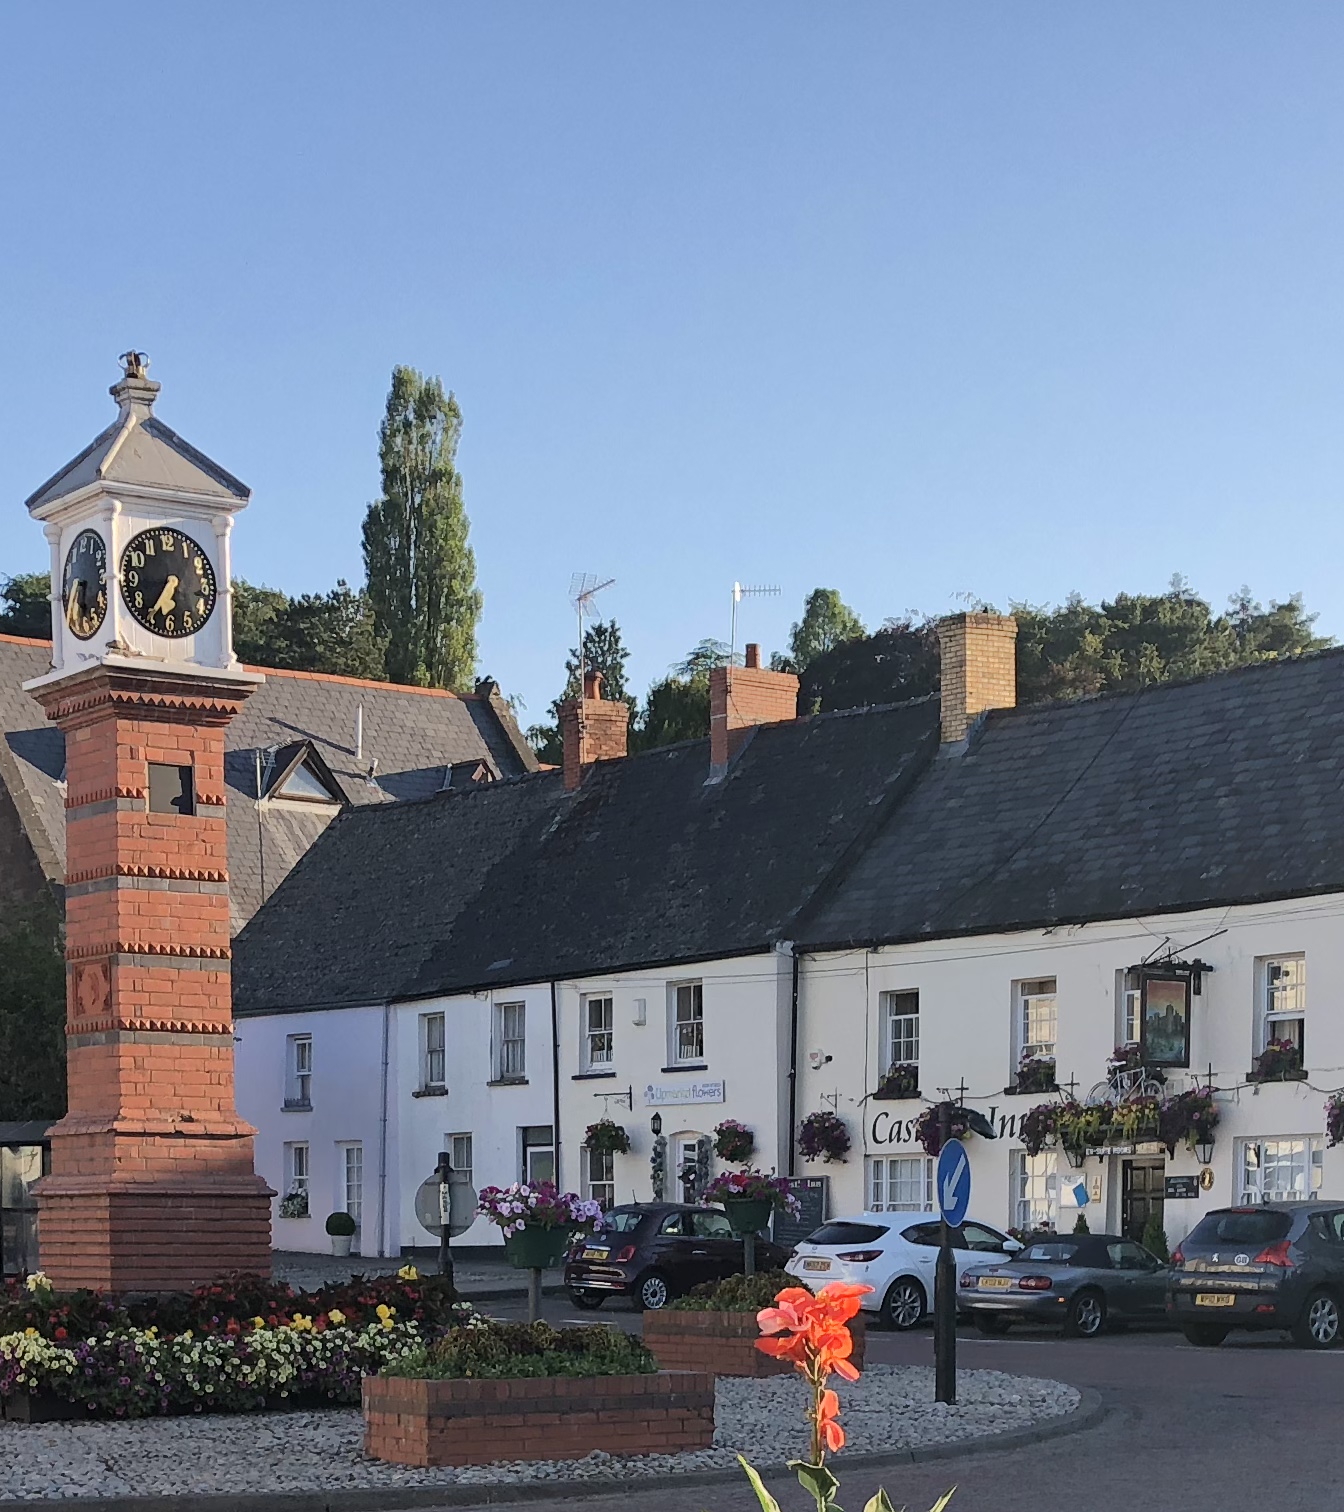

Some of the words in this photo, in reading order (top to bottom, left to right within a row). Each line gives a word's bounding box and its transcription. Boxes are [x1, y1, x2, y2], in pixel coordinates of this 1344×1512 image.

[144, 539, 156, 556] 11
[160, 534, 174, 551] 12
[182, 541, 188, 558] 1
[128, 550, 145, 568] 10
[194, 556, 203, 575] 2
[128, 570, 138, 588] 9
[200, 577, 209, 596] 3
[135, 591, 143, 608] 8
[196, 597, 206, 615] 4
[165, 614, 175, 631] 6
[184, 610, 192, 628] 5
[692, 1085, 721, 1098] flowers
